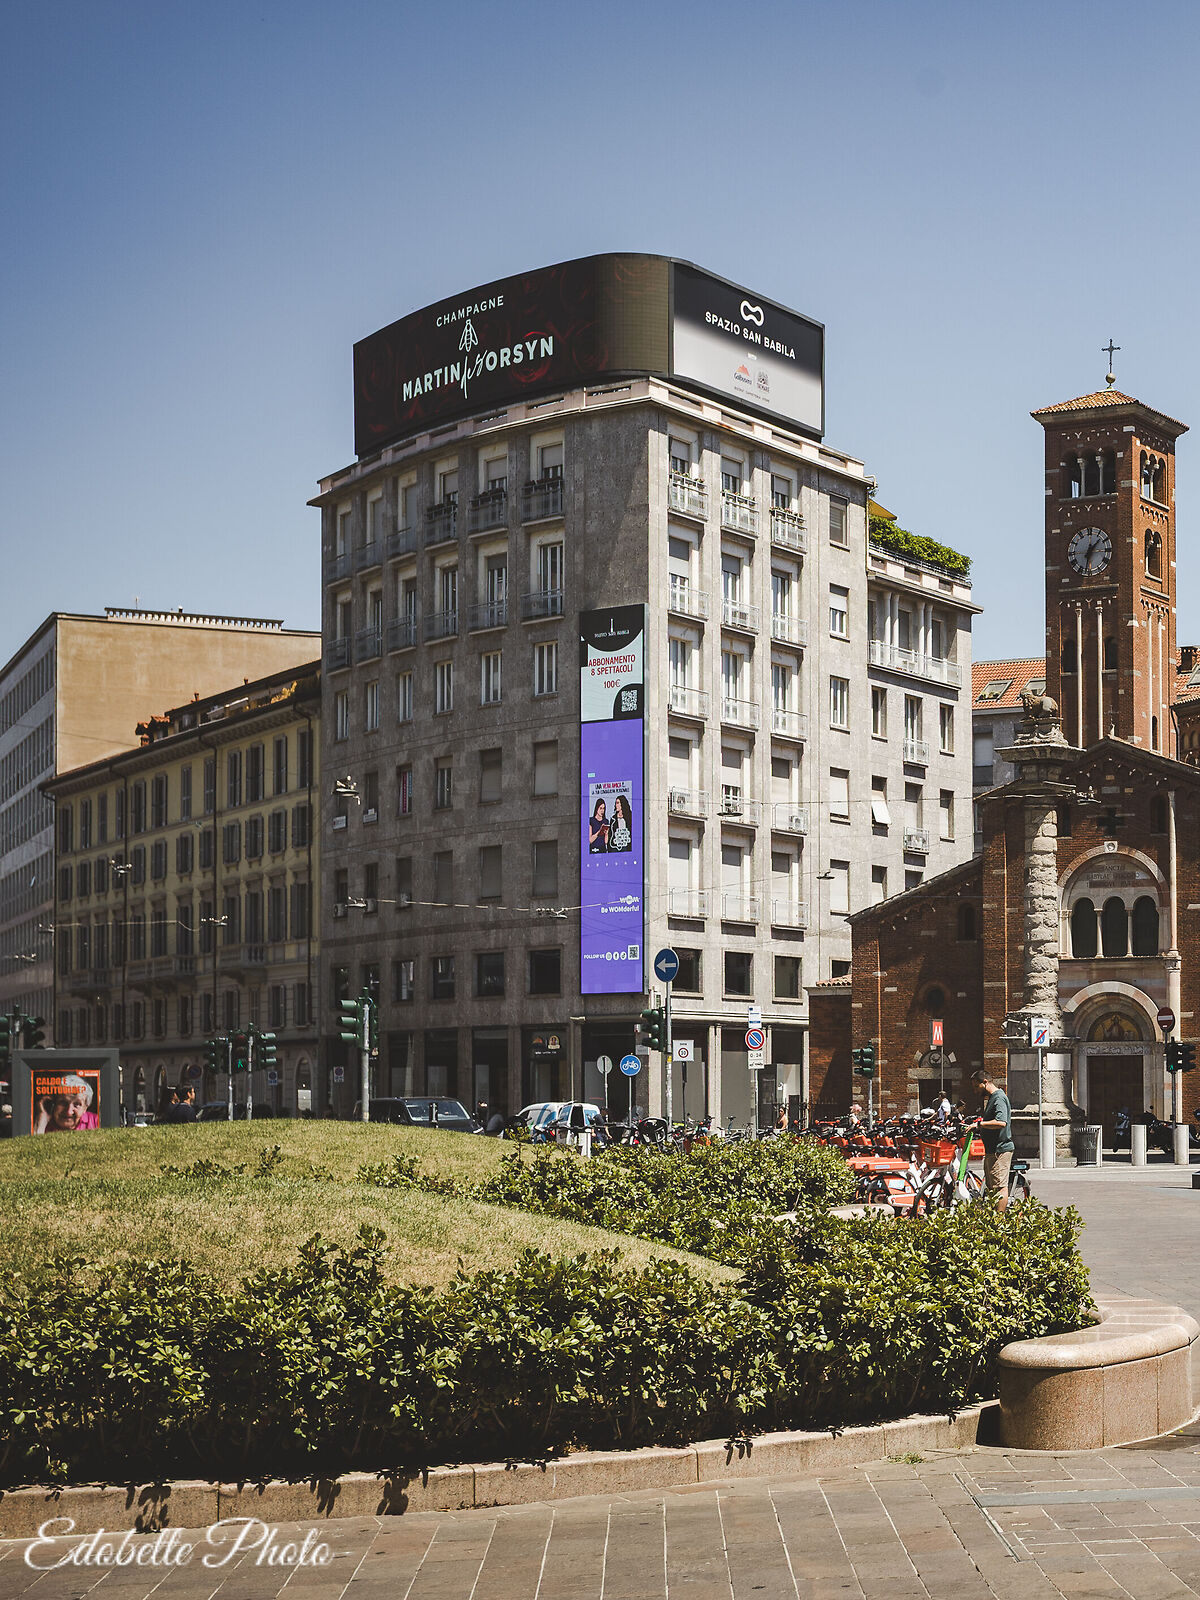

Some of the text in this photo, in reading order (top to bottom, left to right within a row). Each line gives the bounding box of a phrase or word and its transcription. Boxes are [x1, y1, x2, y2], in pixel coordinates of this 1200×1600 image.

[436, 296, 504, 327] CHAMPAGNE
[705, 311, 796, 360] SPAZIO SAN BABILA
[403, 362, 461, 402] MARTIN
[486, 336, 554, 372] ORSYN
[589, 655, 636, 667] ABBONAMENTO
[597, 664, 633, 676] SPETTACOLI
[933, 1025, 943, 1041] M
[36, 1077, 61, 1086] CALDO
[36, 1086, 86, 1095] SOLITUDINE?
